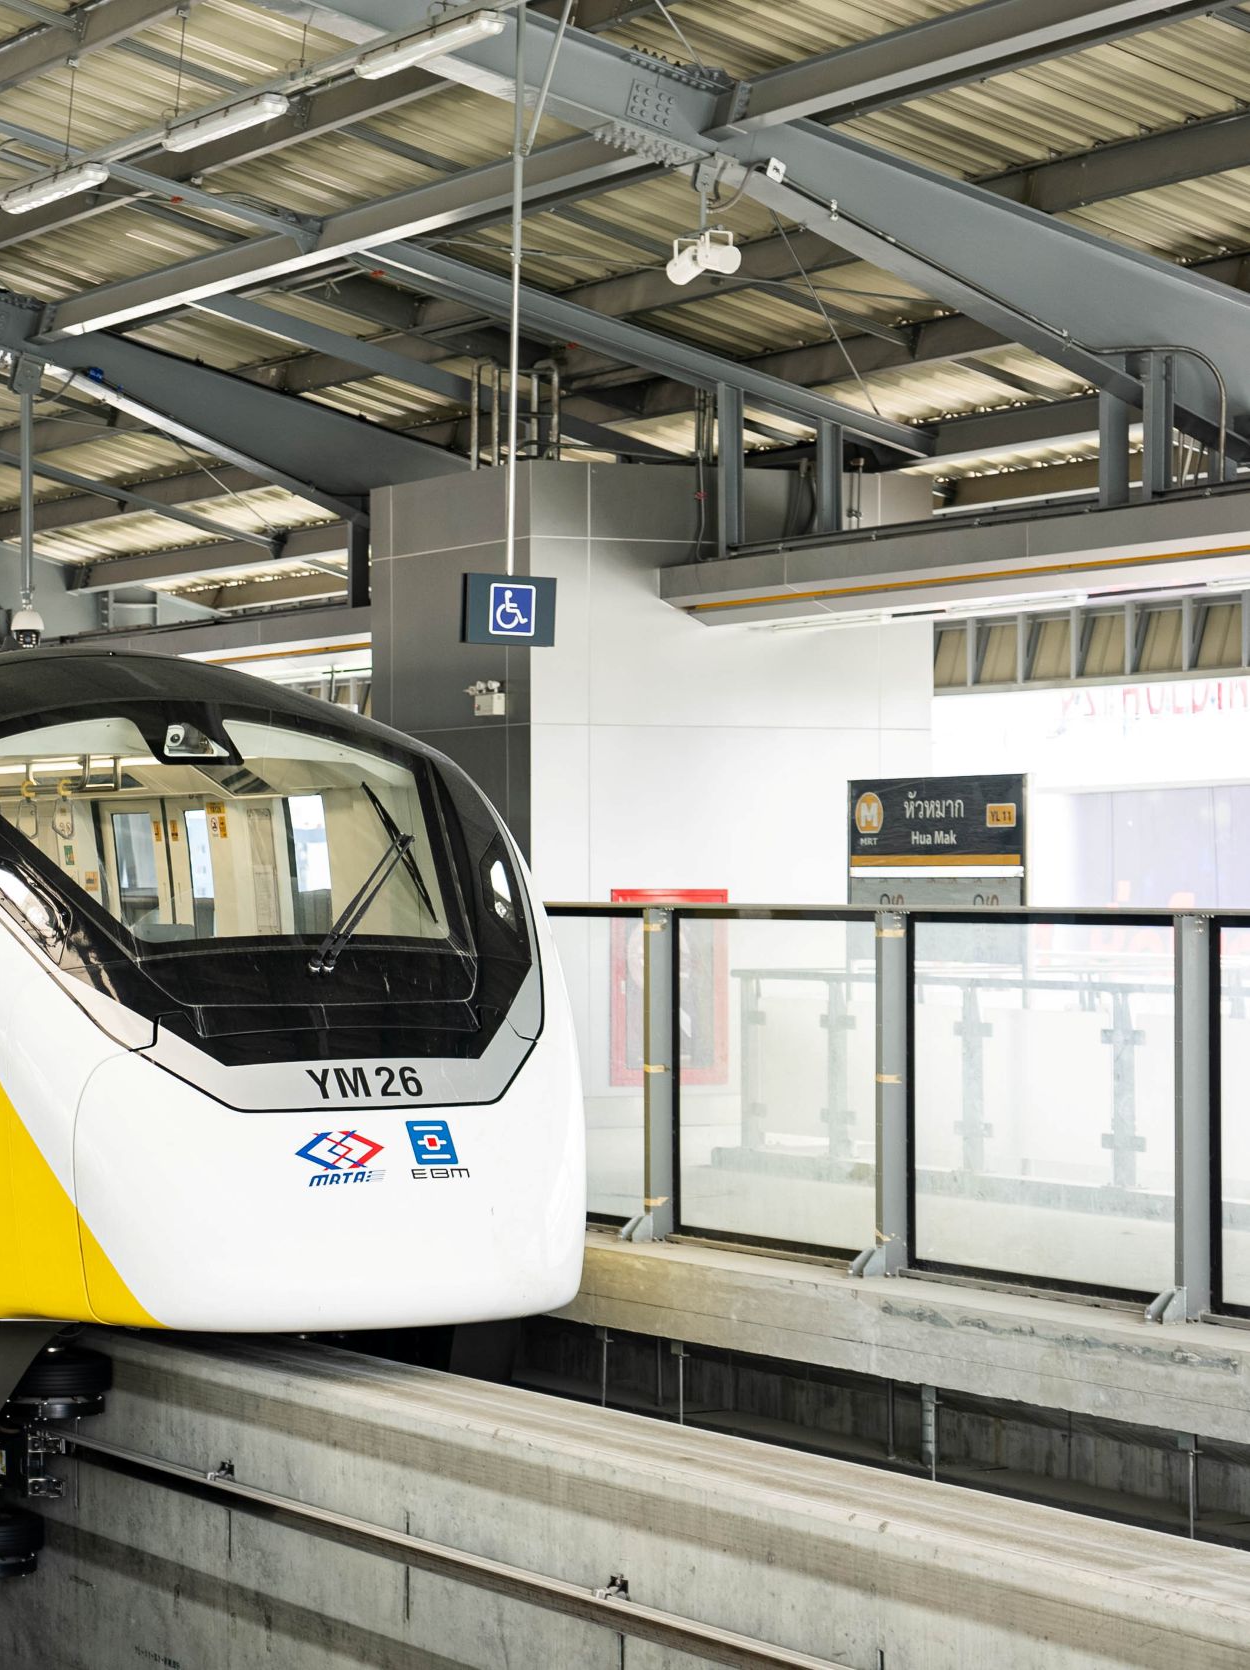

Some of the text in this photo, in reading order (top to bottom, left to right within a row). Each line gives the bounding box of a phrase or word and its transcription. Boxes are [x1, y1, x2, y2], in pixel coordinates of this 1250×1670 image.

[860, 803, 879, 827] M
[903, 791, 965, 819] หัวหมาก
[911, 829, 958, 845] Hua Mak
[309, 1171, 367, 1187] MRTA
